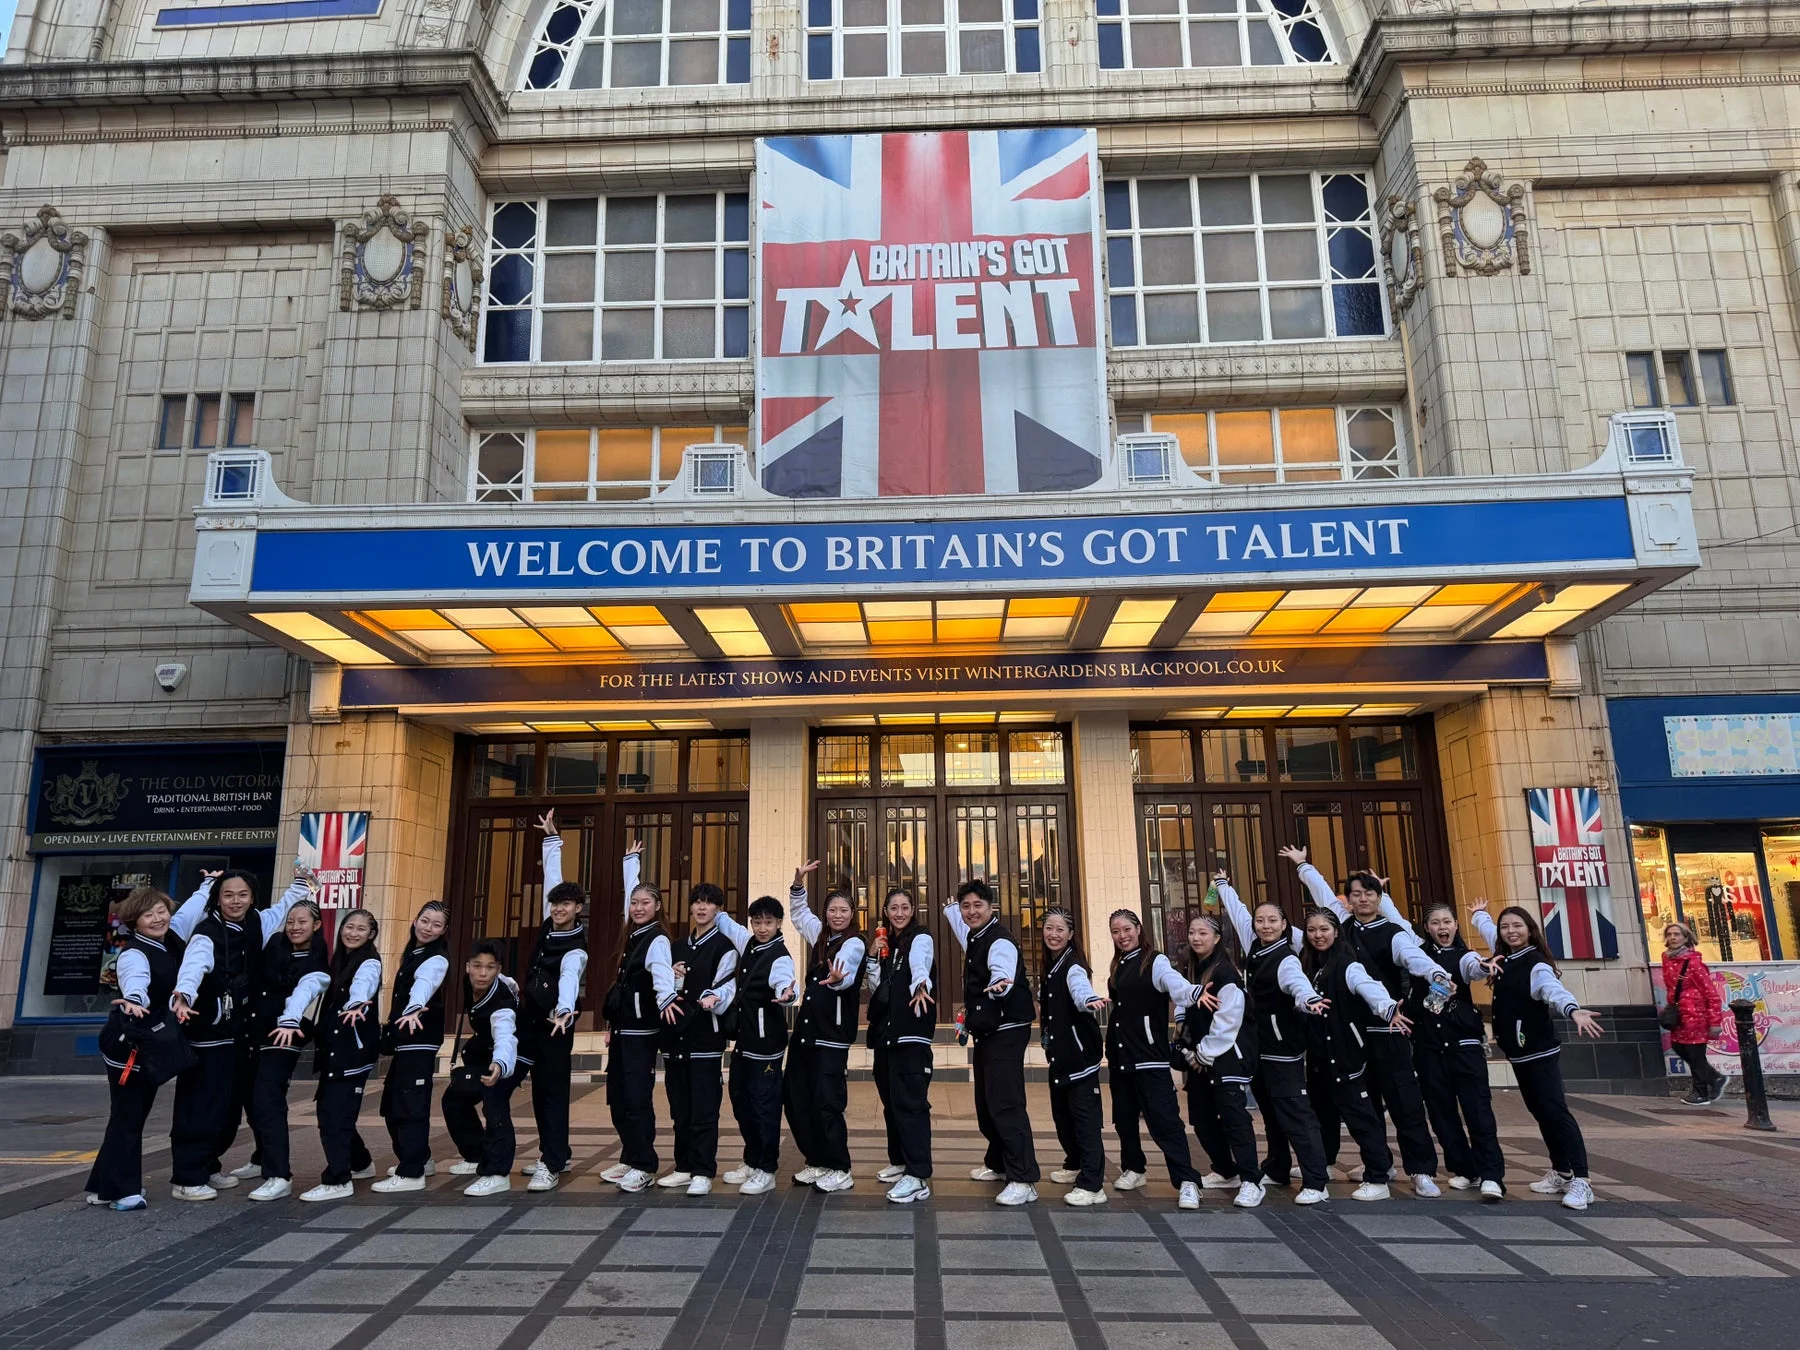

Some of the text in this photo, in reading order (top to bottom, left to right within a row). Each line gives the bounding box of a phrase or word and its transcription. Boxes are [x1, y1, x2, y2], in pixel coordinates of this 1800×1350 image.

[869, 238, 1070, 281] BRITAIN'S GOT
[776, 249, 1080, 354] TALENT
[467, 518, 1409, 577] WELCOME TO BRITAIN'S GOT TALENT
[600, 674, 635, 688] FOR
[639, 673, 673, 687] THE
[680, 672, 737, 687] LATEST
[742, 670, 803, 686] SHOWS
[807, 670, 847, 684] AND
[850, 668, 912, 682] EVENTS
[916, 667, 961, 681] VISIT
[139, 774, 282, 791] THE OLD VICTORIA
[146, 791, 272, 804] TRADITIONAL BRITISH BAR
[153, 804, 263, 814] DRINK ENTERTAINMENT FOOD
[44, 829, 278, 846] OPEN DAILY LIVE ENTERTAINMENT FREE ENTRY
[1588, 845, 1602, 861] GOT
[346, 869, 359, 883] GOT
